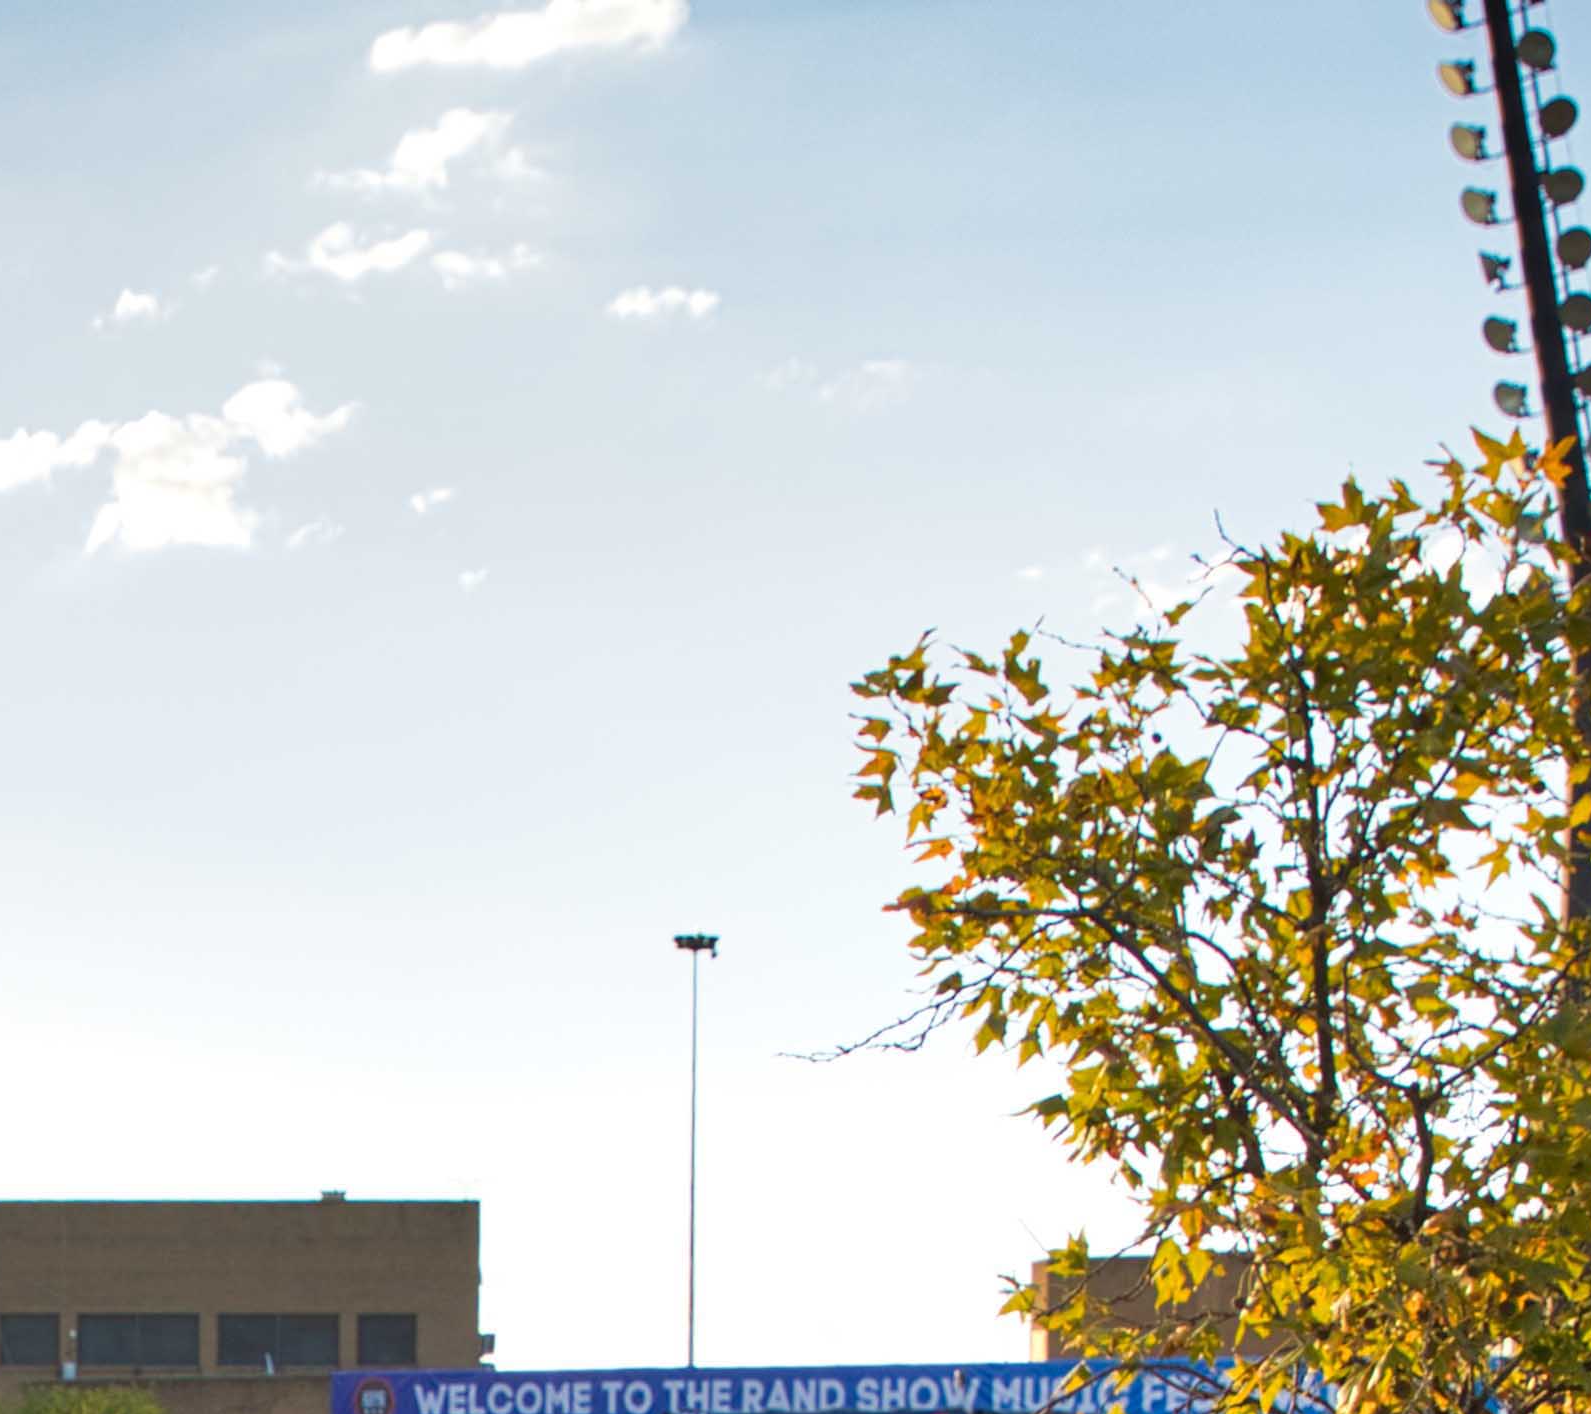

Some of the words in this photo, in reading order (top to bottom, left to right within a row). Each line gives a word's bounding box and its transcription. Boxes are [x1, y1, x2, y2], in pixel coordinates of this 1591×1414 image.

[664, 1379, 732, 1413] THE
[742, 1377, 845, 1412] RAND
[856, 1376, 981, 1412] SHOW
